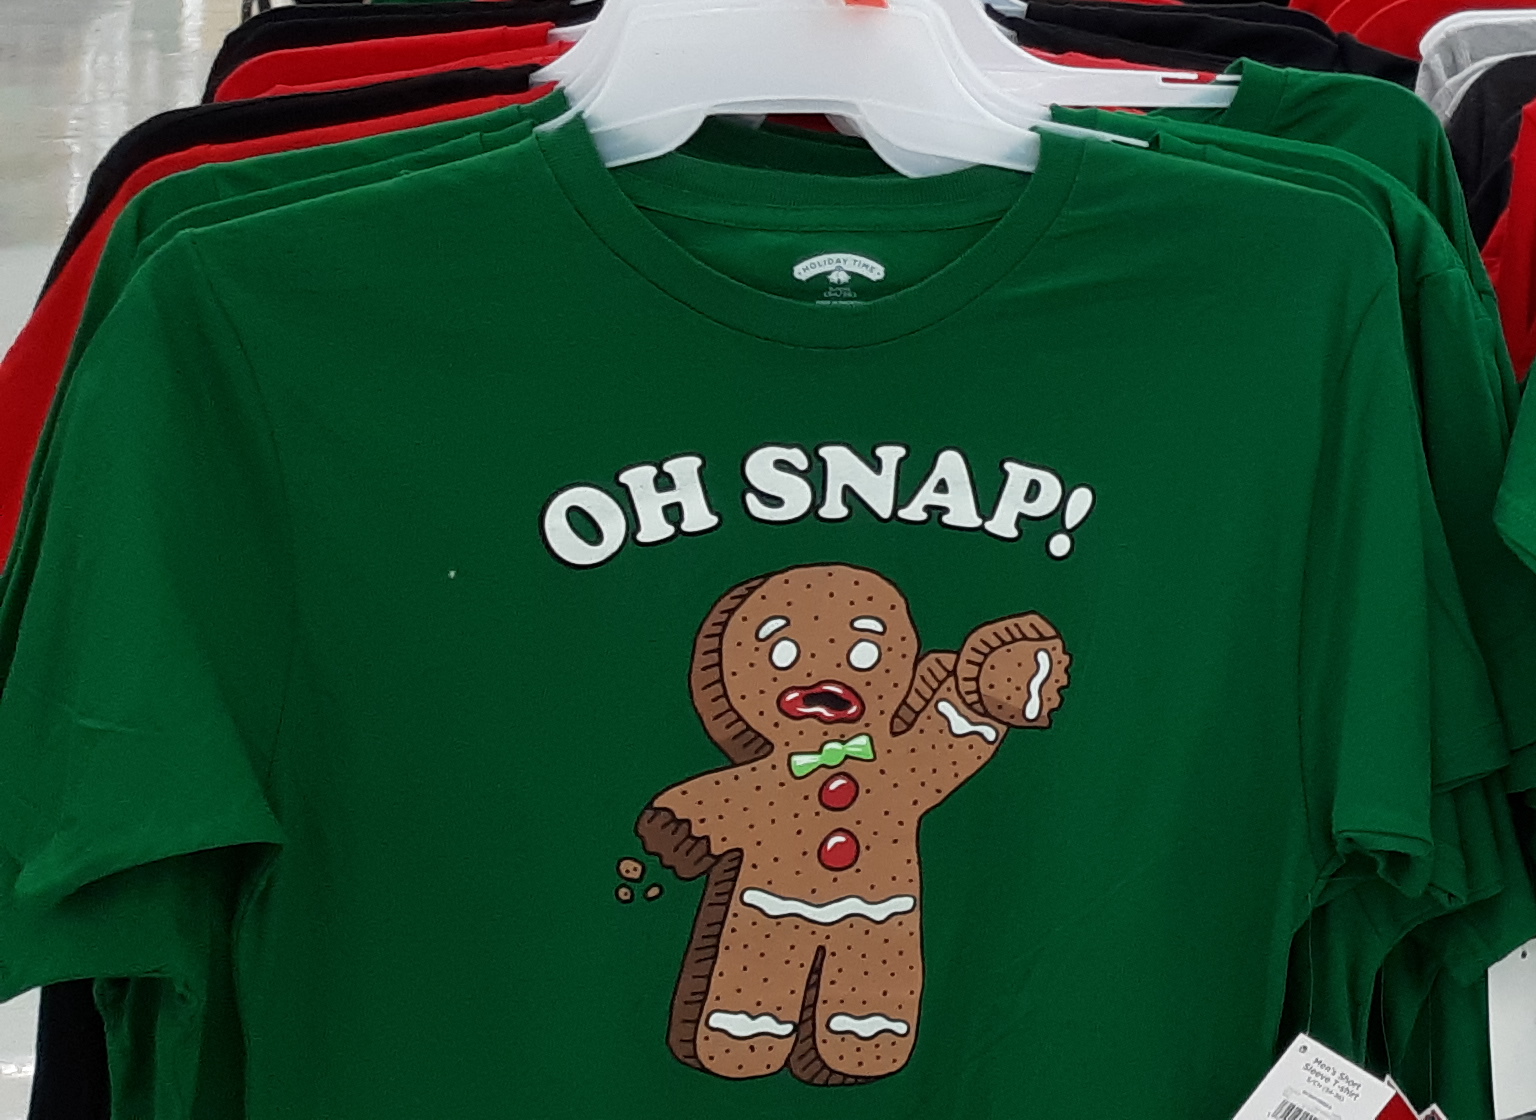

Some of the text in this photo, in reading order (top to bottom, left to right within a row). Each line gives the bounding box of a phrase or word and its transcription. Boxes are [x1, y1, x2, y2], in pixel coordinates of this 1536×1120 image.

[802, 257, 876, 274] HOLIDAY TIME
[541, 443, 1096, 568] OH SNAP!
[1302, 1062, 1331, 1084] Sleeve
[1333, 1079, 1361, 1102] T-shirt
[1338, 1071, 1362, 1091] Short
